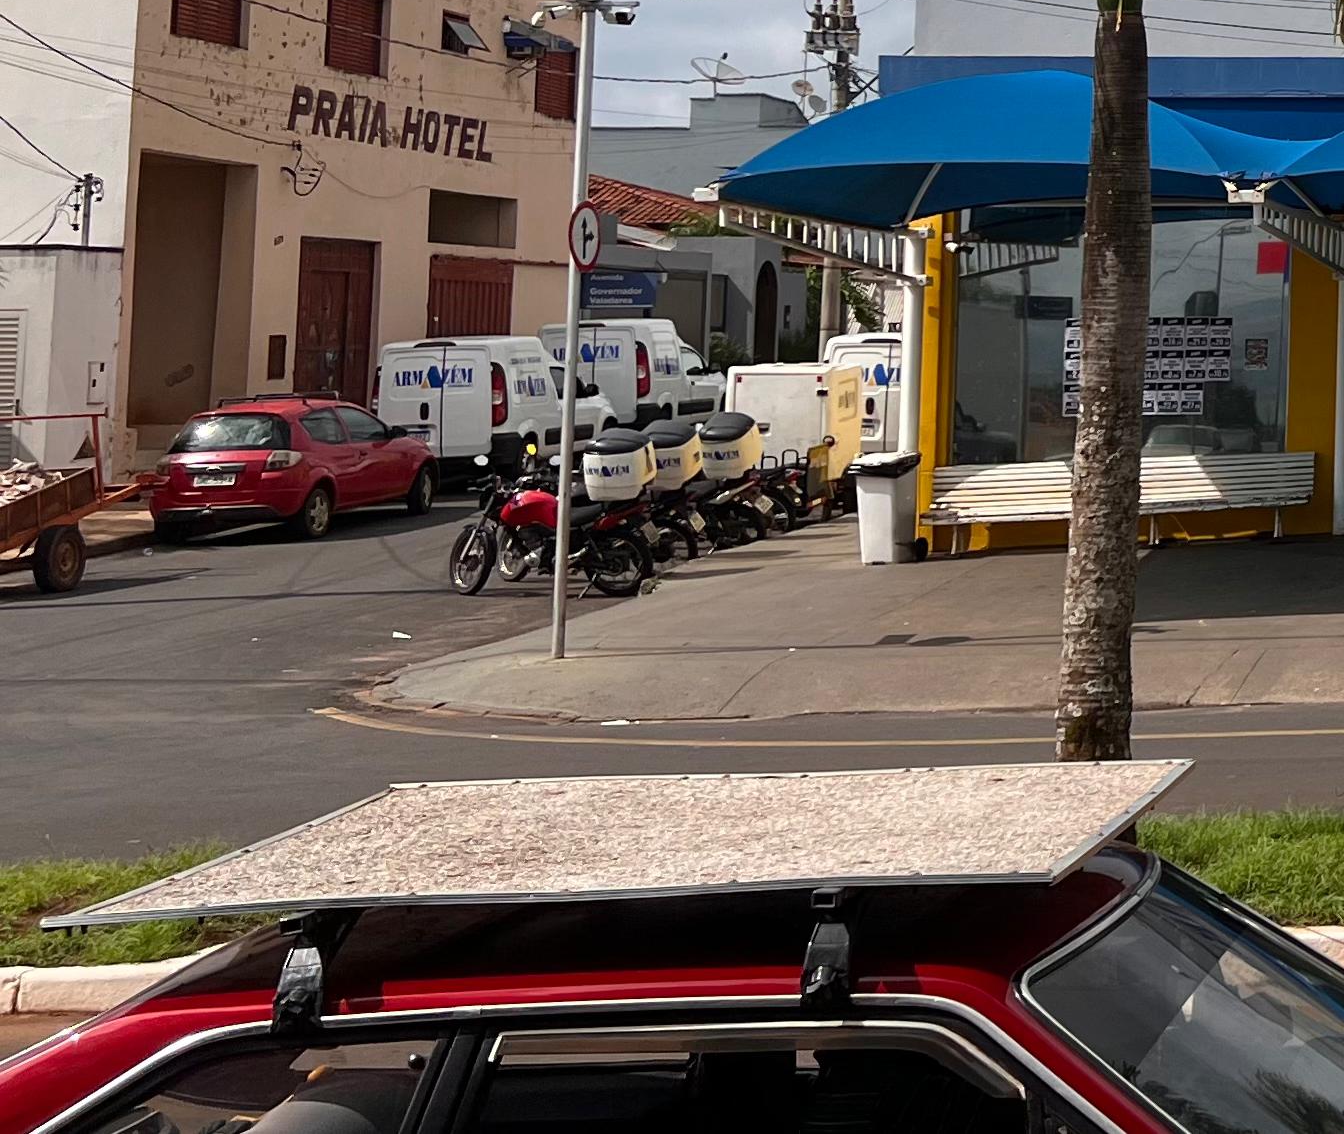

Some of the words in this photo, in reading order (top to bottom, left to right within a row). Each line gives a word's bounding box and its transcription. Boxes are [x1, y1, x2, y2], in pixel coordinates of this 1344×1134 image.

[286, 83, 388, 149] PRAIA
[399, 105, 493, 163] HOTEL
[589, 287, 643, 295] Governador
